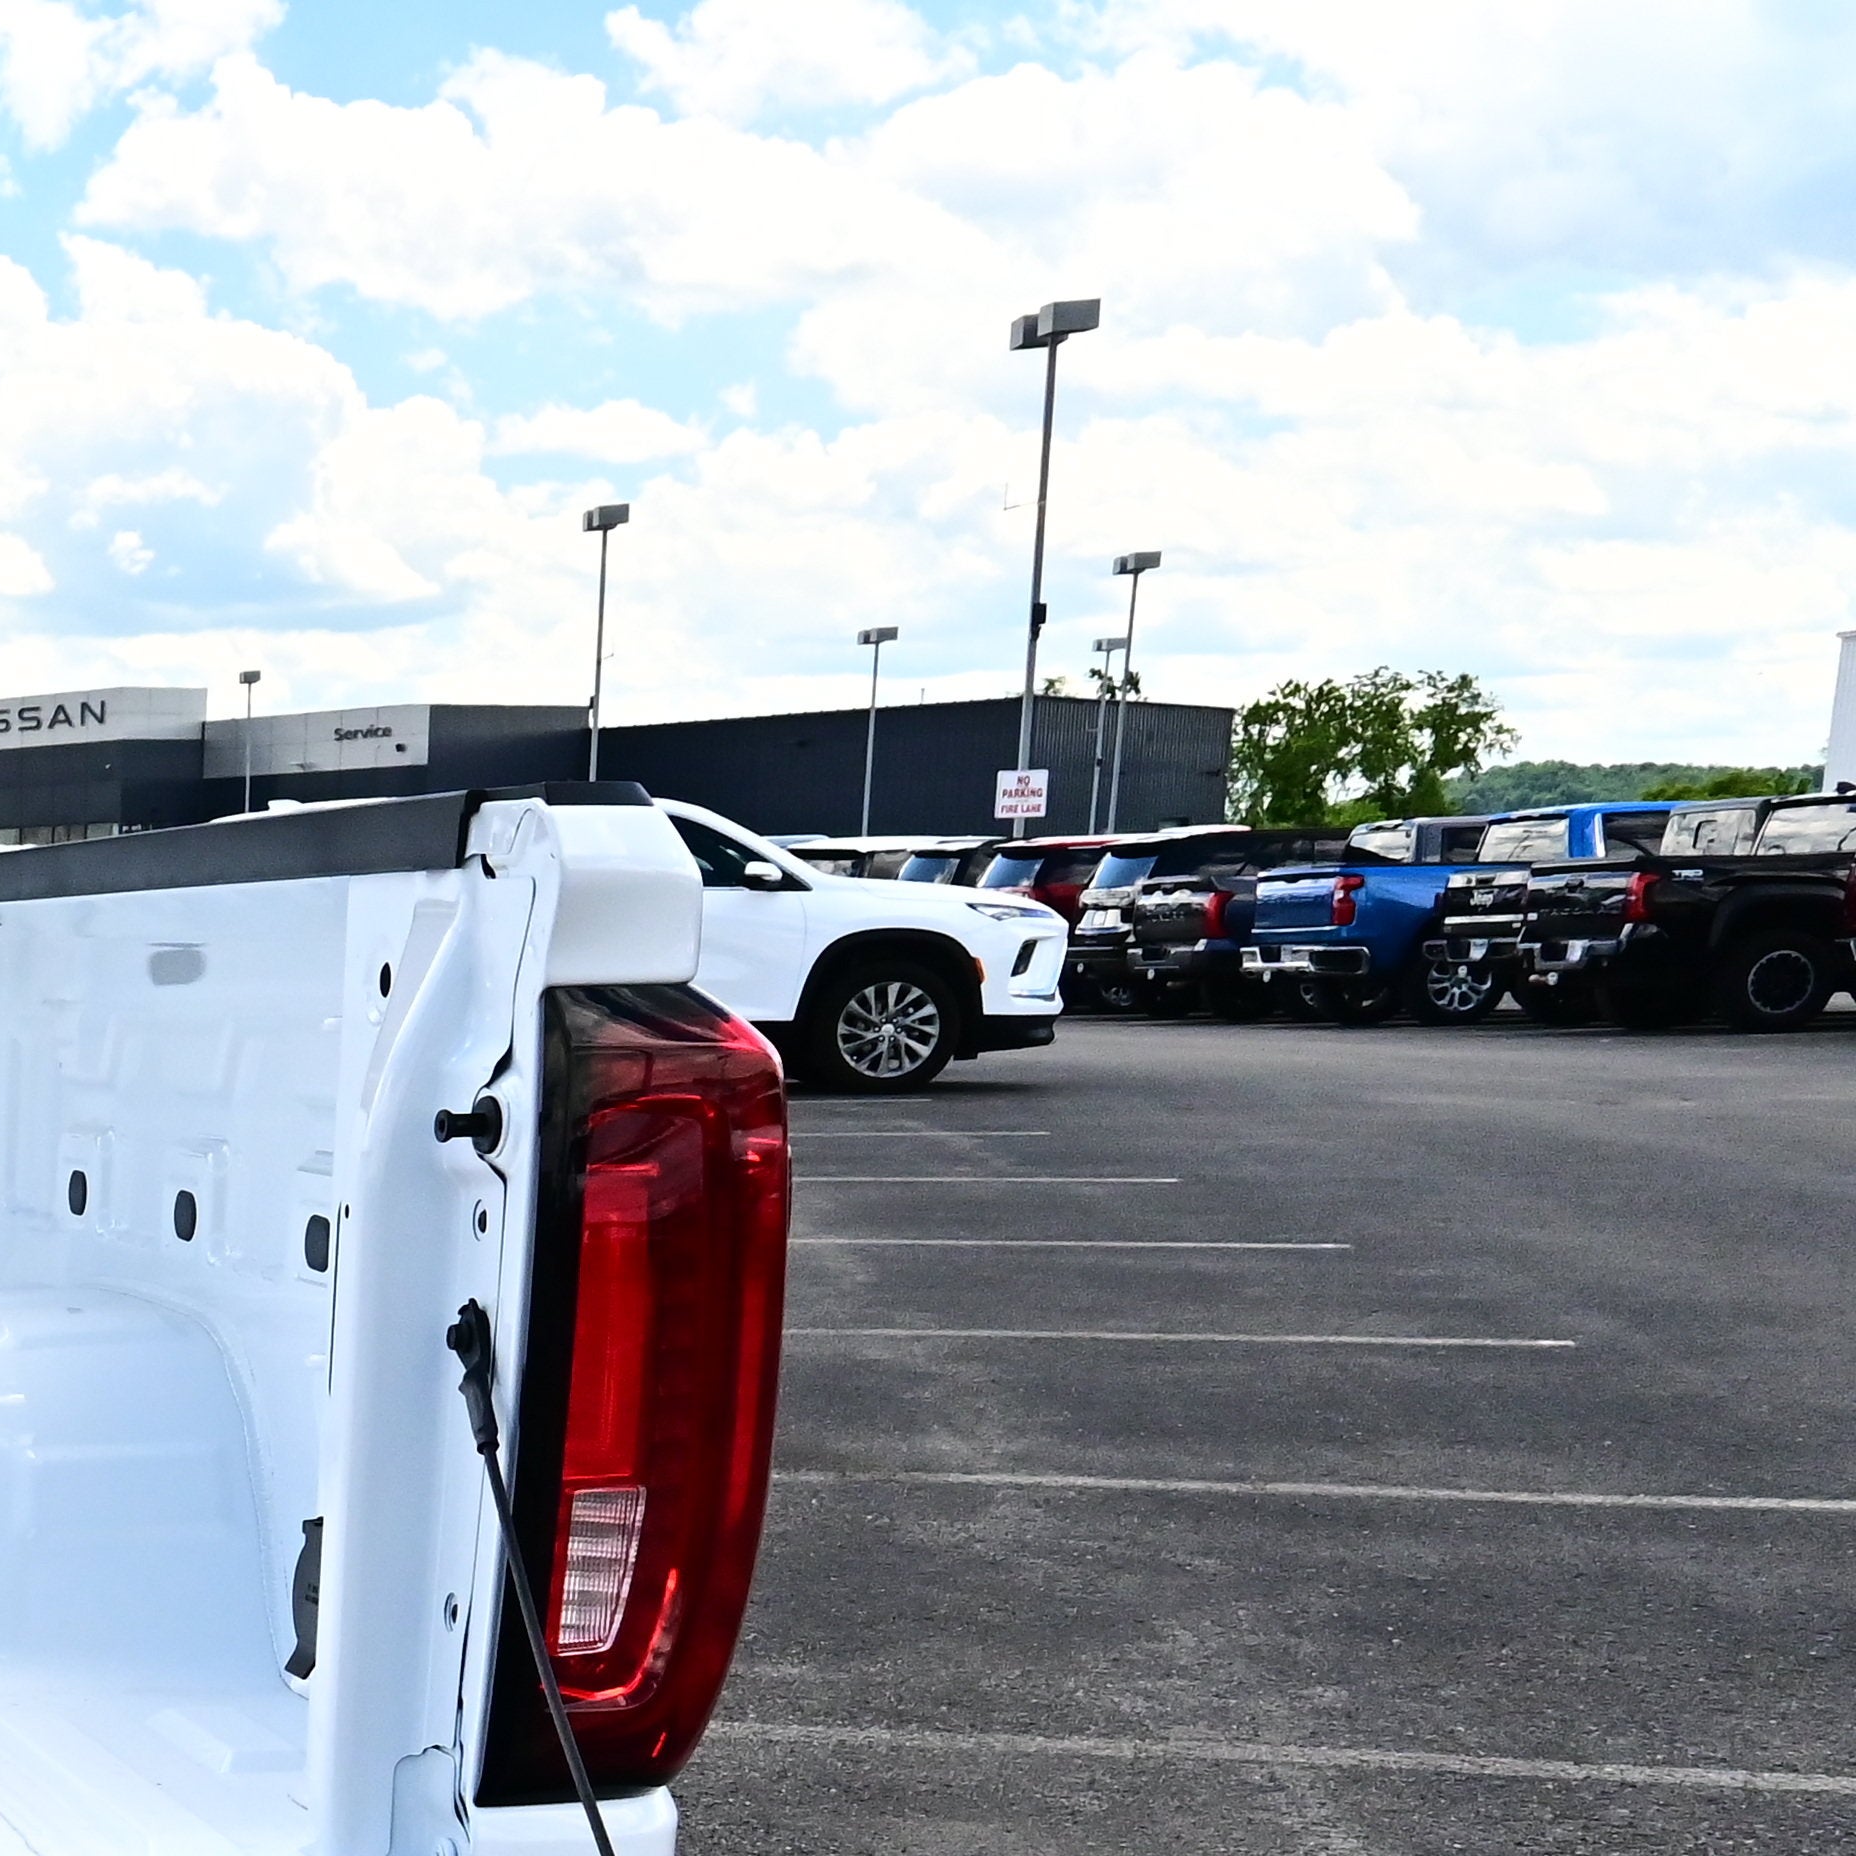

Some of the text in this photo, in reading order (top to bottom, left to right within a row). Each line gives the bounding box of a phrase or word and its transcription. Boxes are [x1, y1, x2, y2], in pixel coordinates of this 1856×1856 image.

[334, 724, 392, 741] Service
[1017, 775, 1031, 786] NO
[1001, 788, 1043, 798] PARKING
[1001, 804, 1041, 814] FIRE LANE
